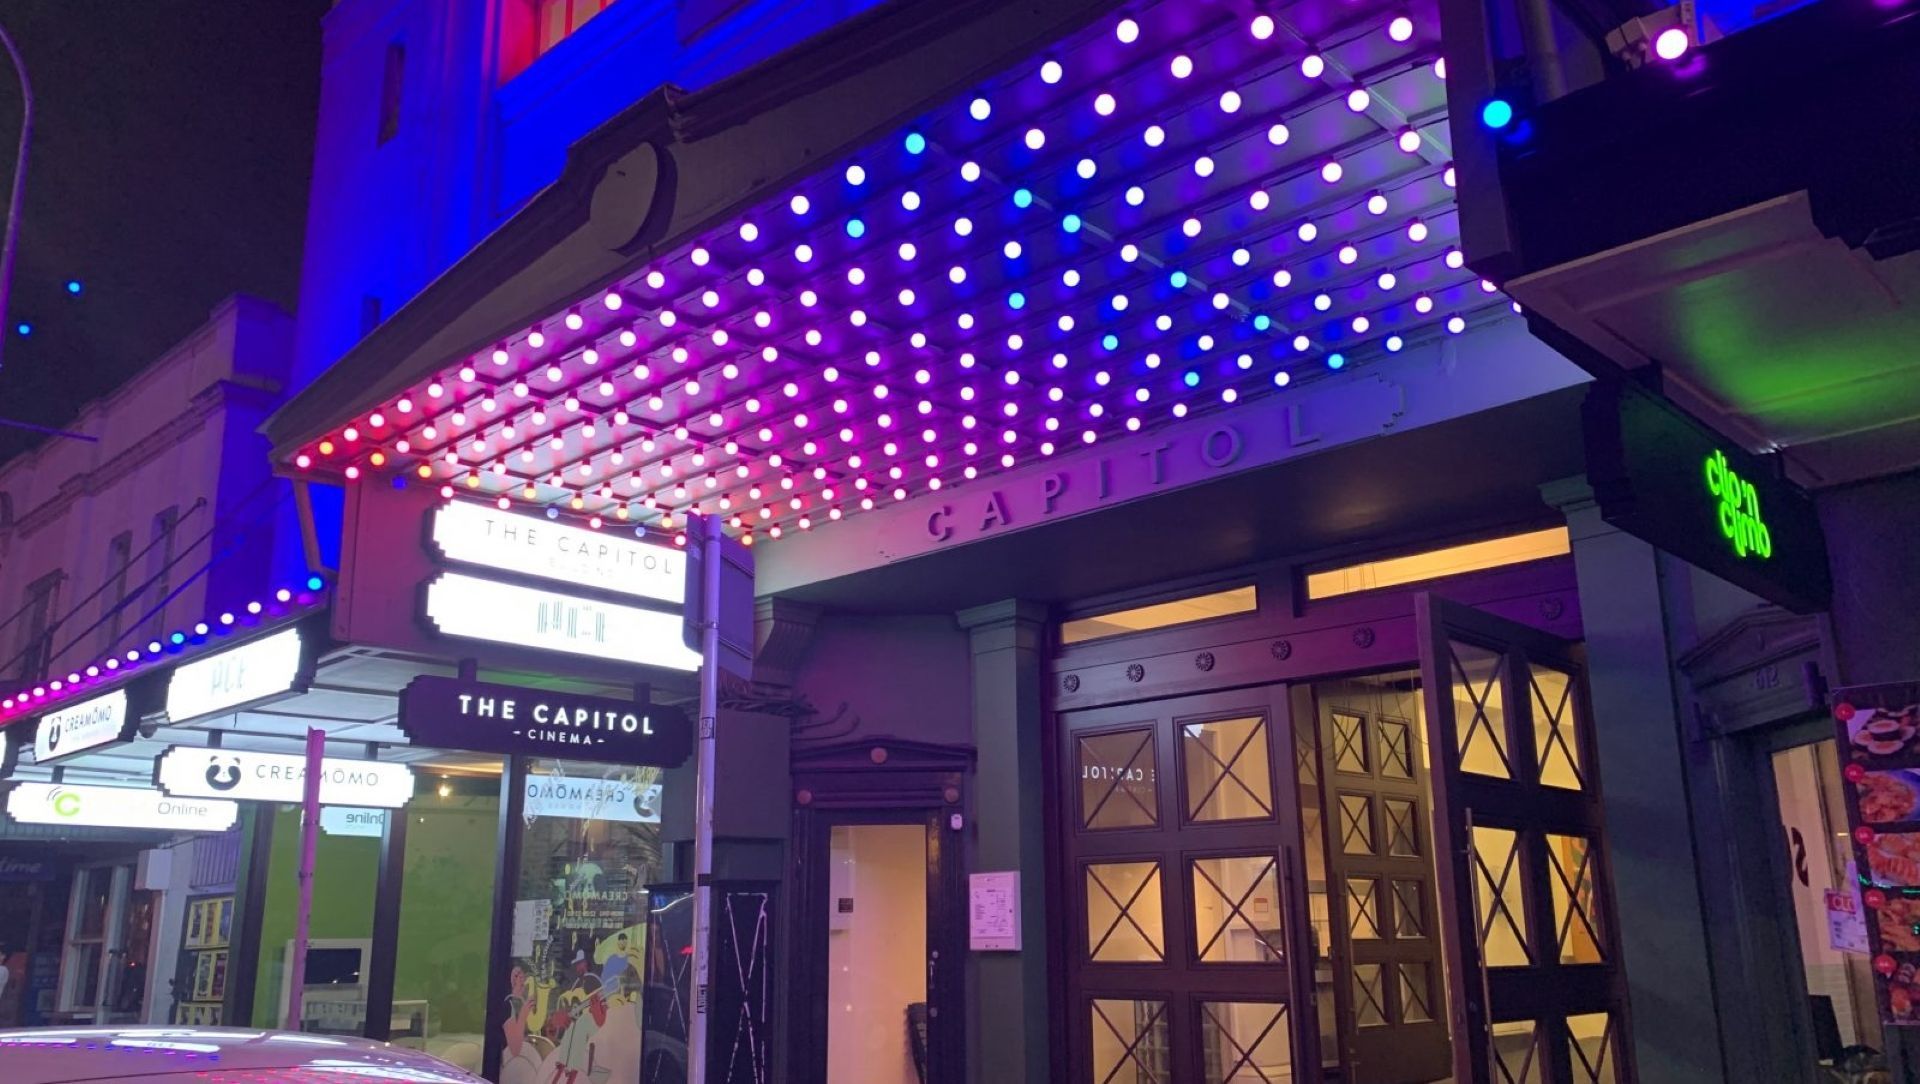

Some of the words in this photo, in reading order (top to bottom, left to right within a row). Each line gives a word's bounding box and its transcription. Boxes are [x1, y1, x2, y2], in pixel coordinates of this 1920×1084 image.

[927, 403, 1321, 542] CAPITOL
[485, 519, 537, 546] THE
[557, 536, 672, 575] CAPITOL
[458, 695, 516, 719] THE
[533, 704, 654, 735] CAPITOL
[528, 729, 592, 745] CINEMA
[157, 801, 208, 817] Online
